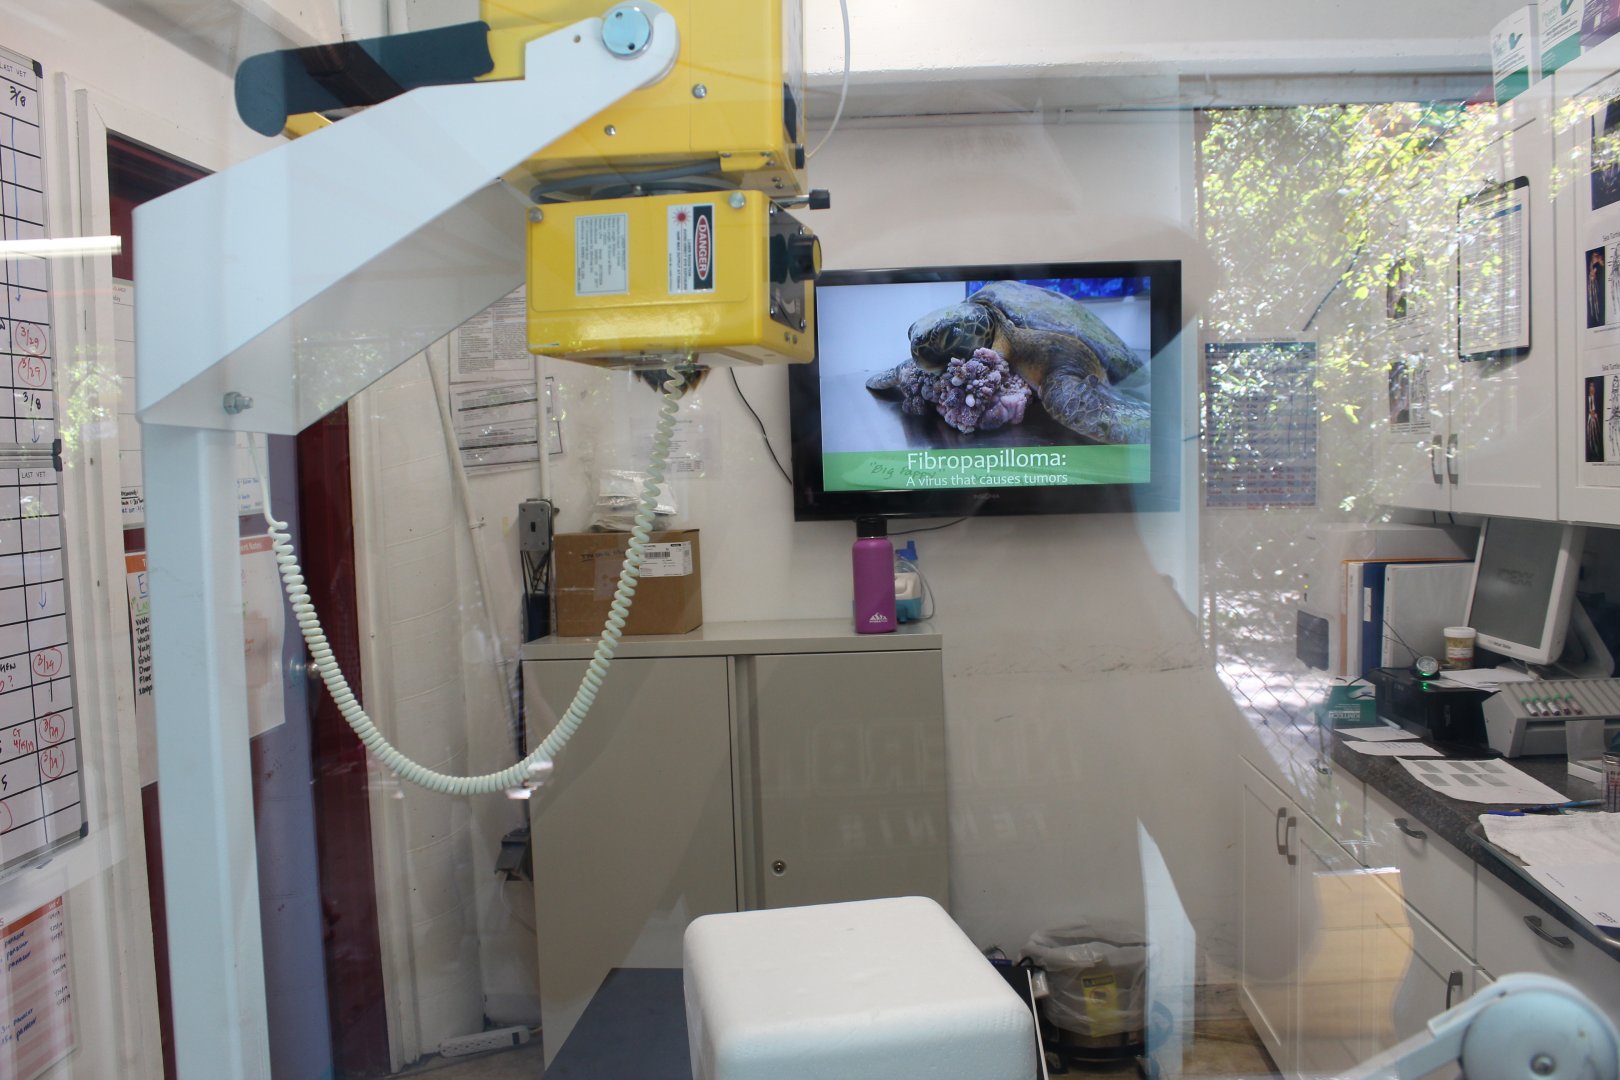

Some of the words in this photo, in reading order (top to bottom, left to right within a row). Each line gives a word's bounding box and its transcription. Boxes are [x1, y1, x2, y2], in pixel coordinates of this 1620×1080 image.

[698, 223, 708, 272] DANGER
[906, 449, 1068, 473] Fibropapilloma:
[21, 471, 34, 479] LAST
[906, 476, 916, 487] A
[917, 474, 948, 486] virus
[951, 474, 977, 485] that
[979, 473, 1022, 485] causes
[1023, 473, 1069, 484] tumors
